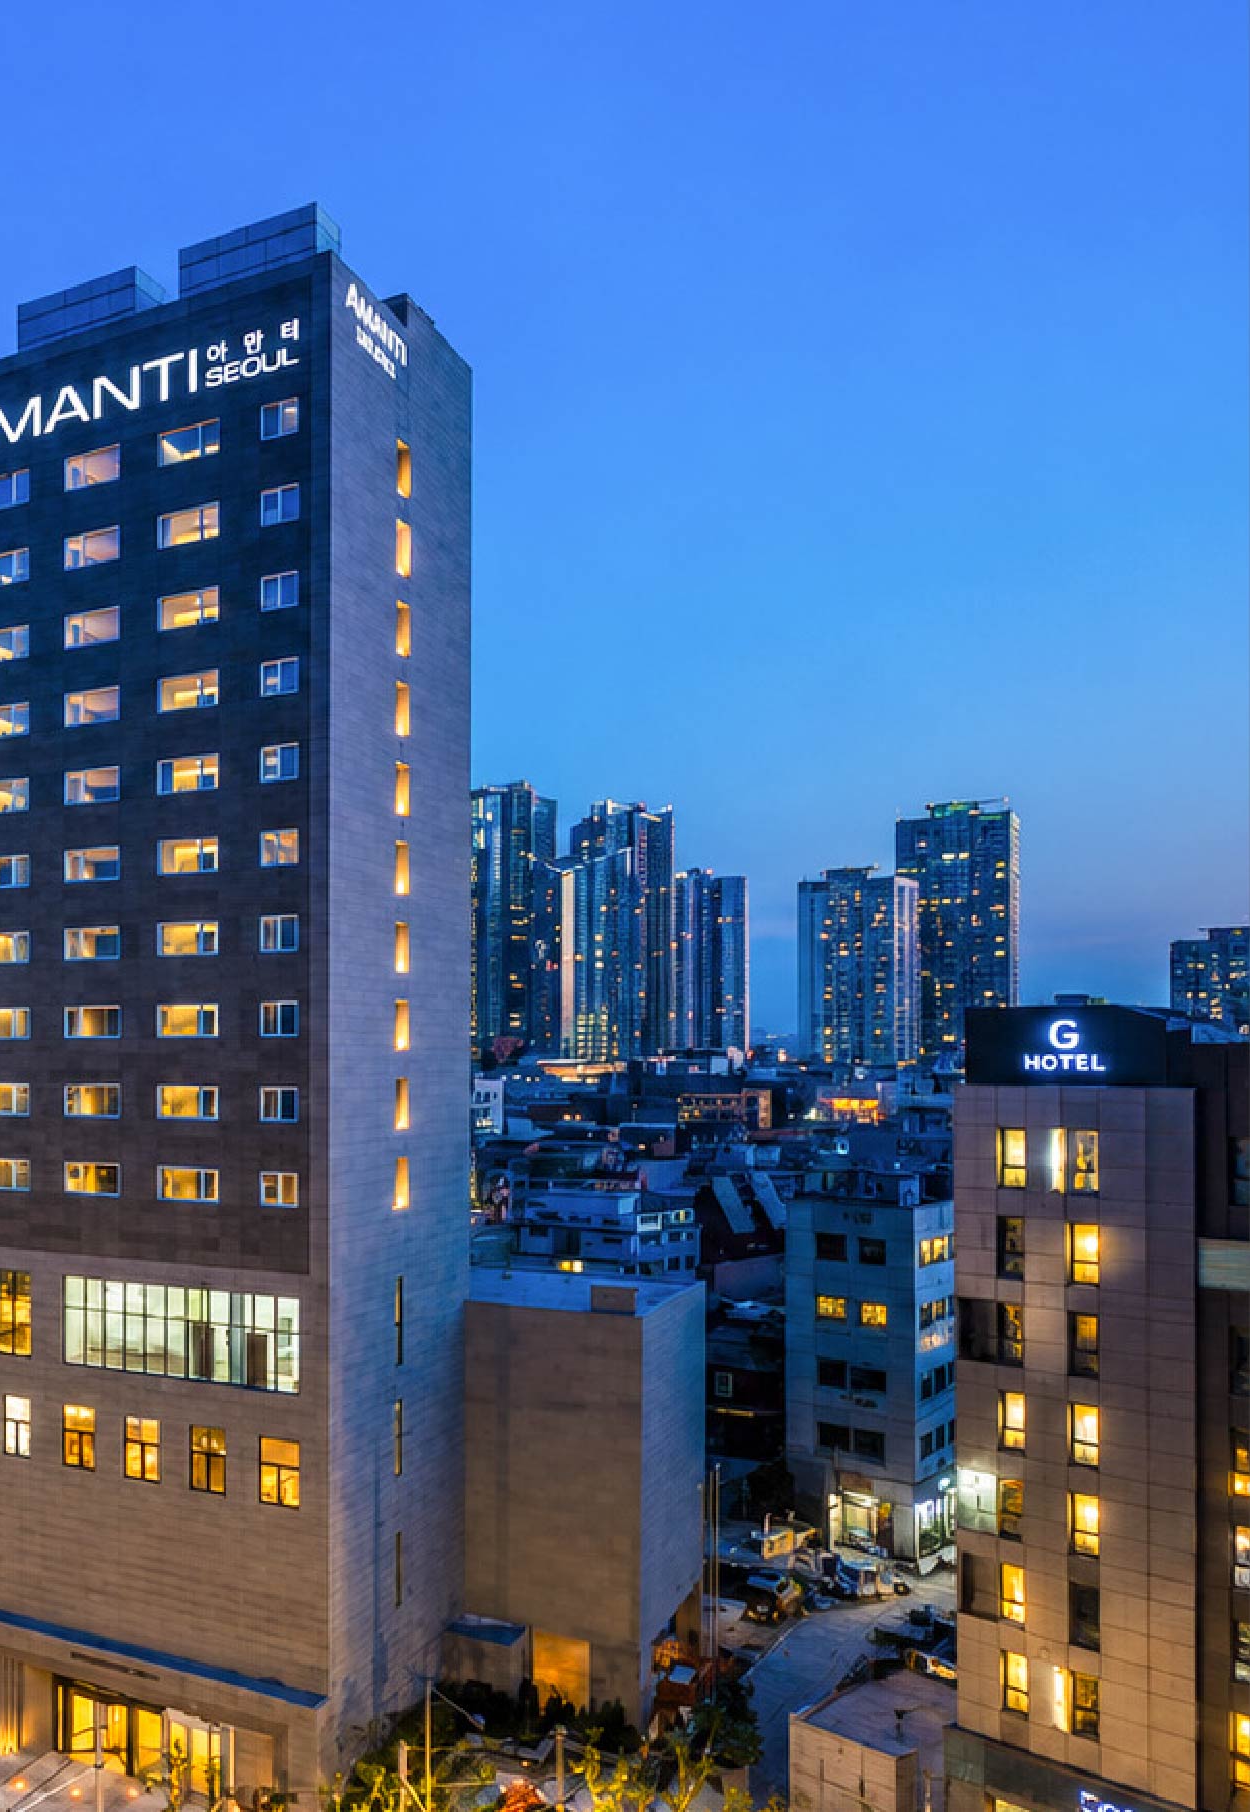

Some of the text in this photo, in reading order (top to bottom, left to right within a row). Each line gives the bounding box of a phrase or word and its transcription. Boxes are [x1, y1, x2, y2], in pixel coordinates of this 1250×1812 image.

[205, 347, 300, 388] SEOUL
[1049, 1020, 1080, 1050] G
[1023, 1053, 1107, 1072] HOTEL
